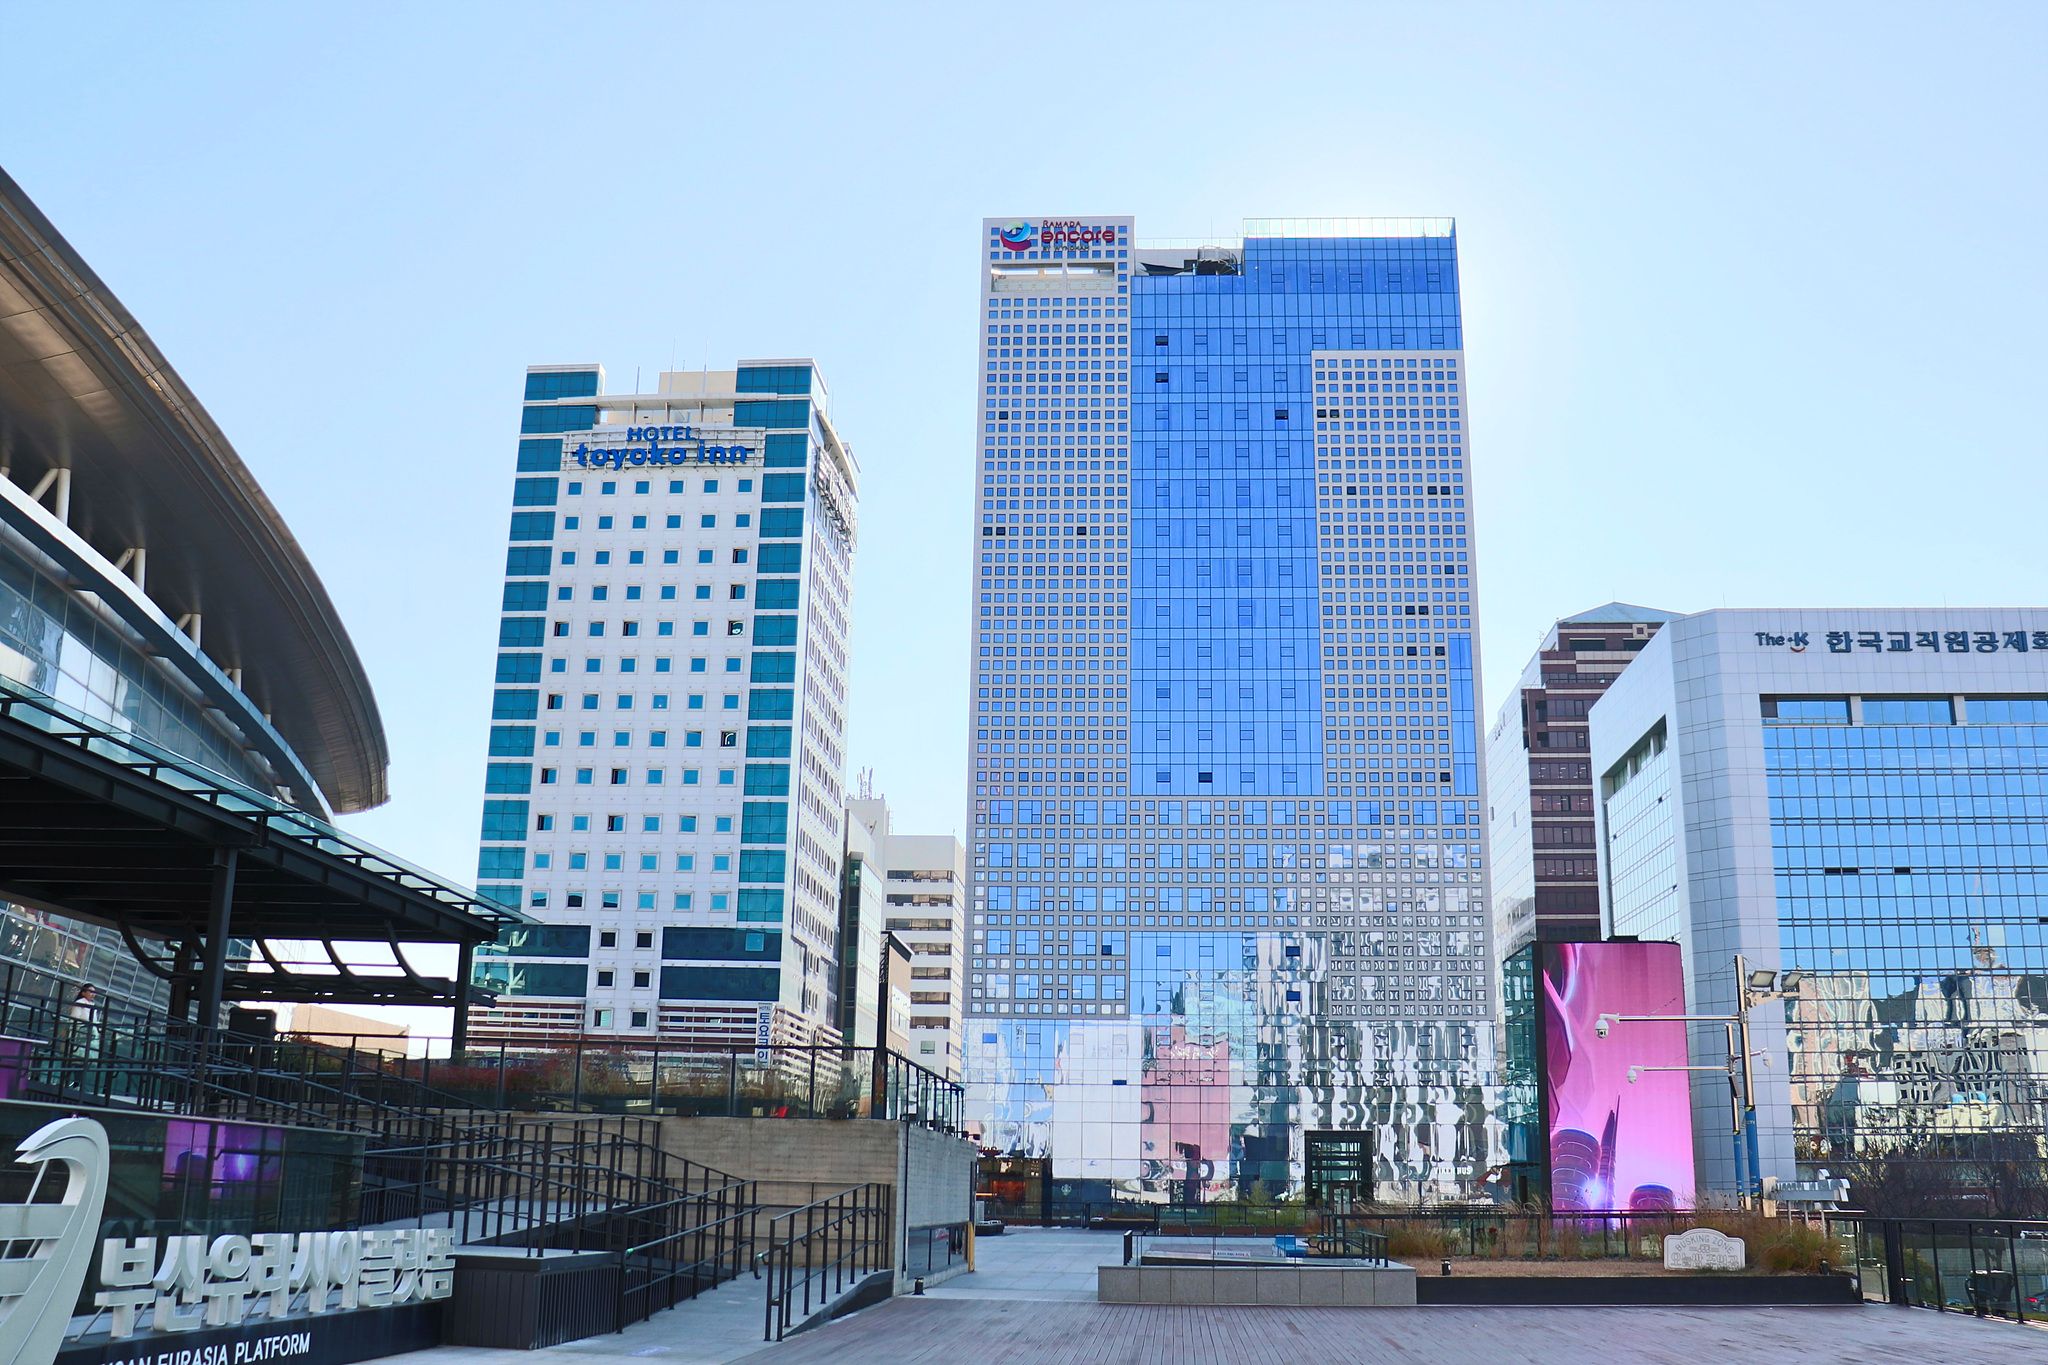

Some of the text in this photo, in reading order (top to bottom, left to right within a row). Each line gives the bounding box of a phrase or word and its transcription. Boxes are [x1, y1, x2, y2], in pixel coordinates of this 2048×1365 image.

[1043, 220, 1081, 228] RAMADA
[1041, 230, 1115, 244] encore
[626, 426, 696, 442] HOTEL
[574, 439, 748, 472] toyoko inn
[1675, 1234, 1735, 1255] BUSKING ZONE
[234, 1332, 311, 1365] PLATFORM
